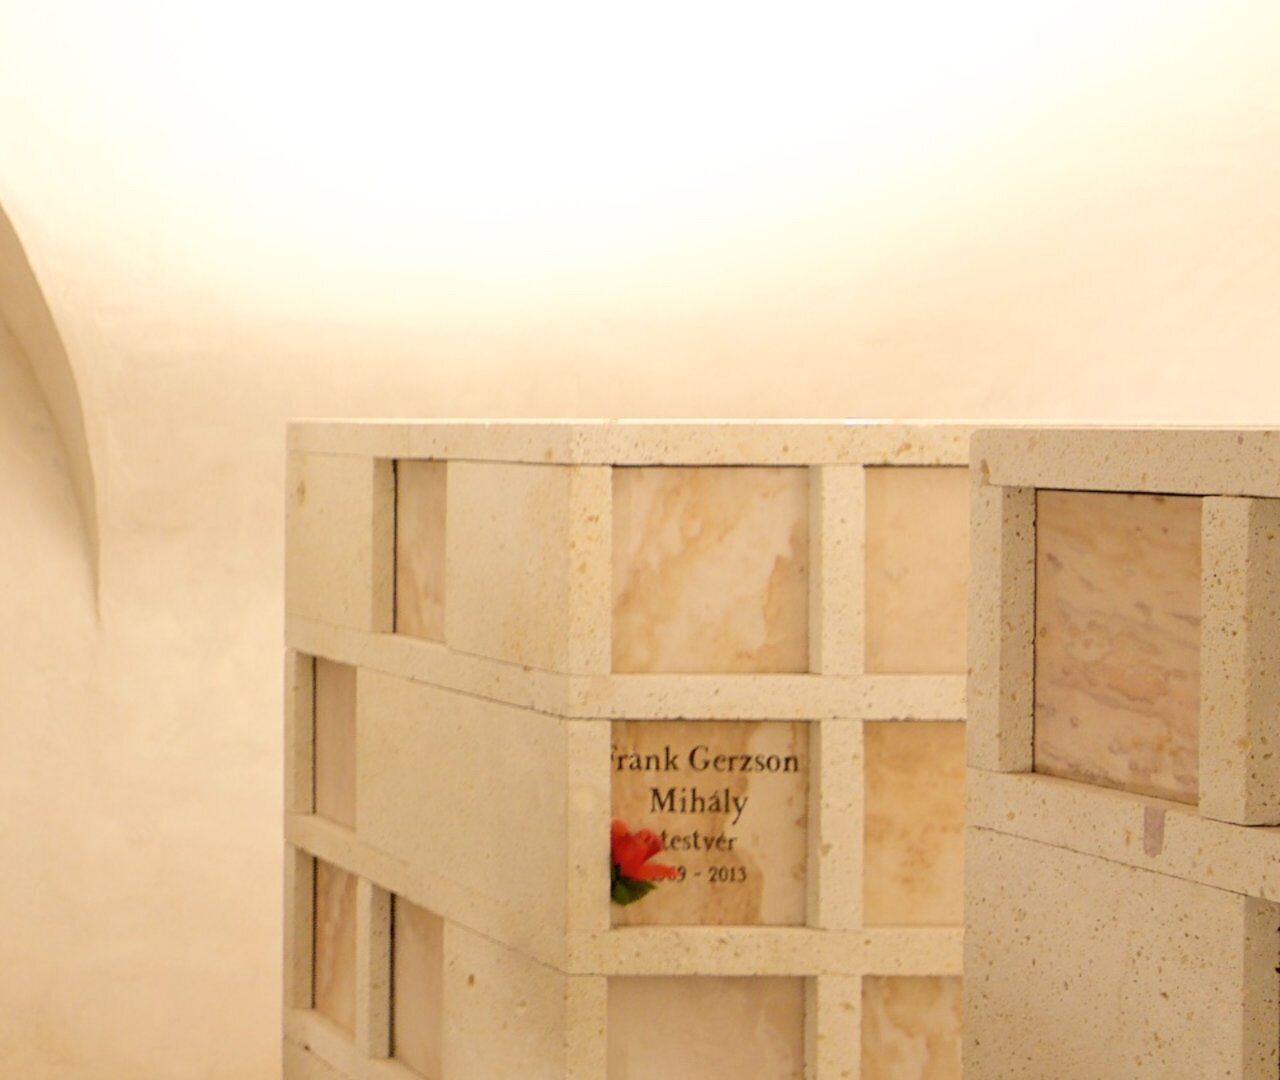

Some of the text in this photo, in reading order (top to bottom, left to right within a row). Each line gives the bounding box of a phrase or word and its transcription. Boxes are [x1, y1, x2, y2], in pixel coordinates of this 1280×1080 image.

[688, 744, 800, 773] Gerzson
[650, 786, 749, 825] Mihály
[660, 827, 738, 851] testvér
[707, 864, 748, 883] 2013
